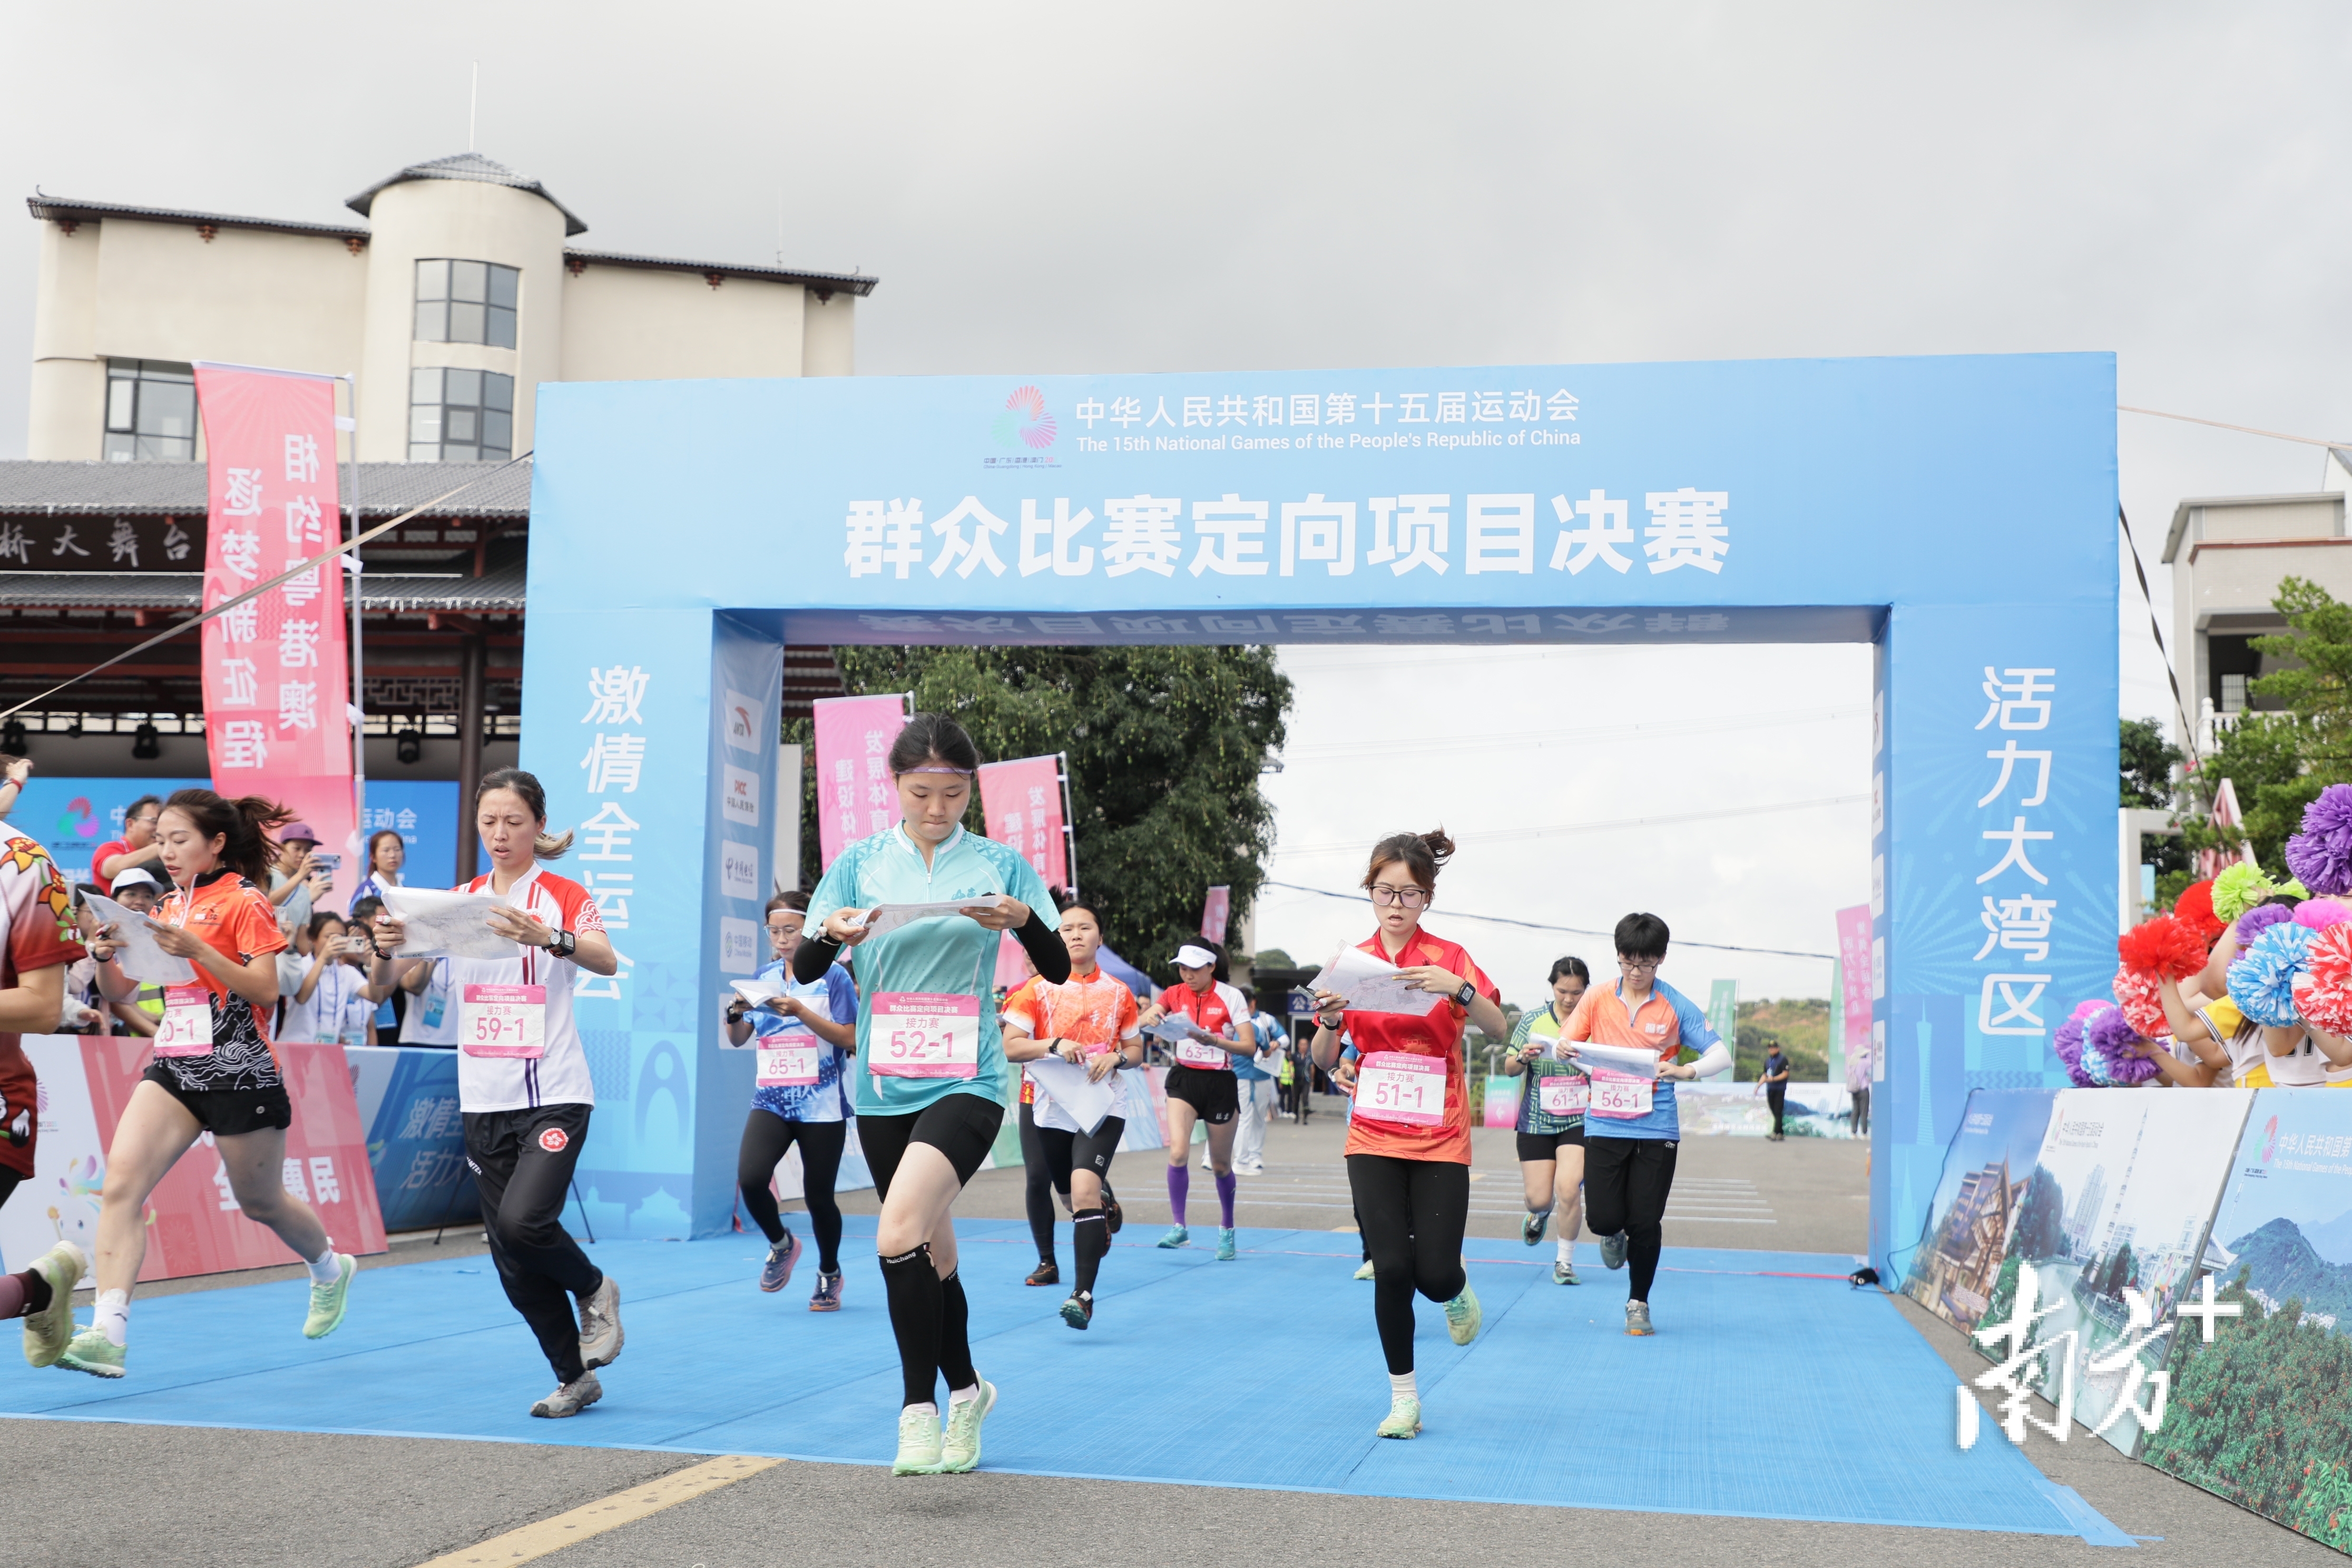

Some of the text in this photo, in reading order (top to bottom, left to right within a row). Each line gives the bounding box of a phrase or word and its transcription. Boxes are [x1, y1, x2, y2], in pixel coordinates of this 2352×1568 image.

[1076, 388, 1580, 429] 中华人民共和国第十五届运动会
[1076, 429, 1580, 452] The 15th National Games of the People's Republic of China
[842, 486, 1730, 580] 群众比赛定向项目决赛
[573, 665, 650, 1001] 激情全运会
[1973, 666, 2057, 1036] 活力大湾区
[487, 1005, 512, 1015] 接力赛
[889, 1005, 959, 1014] 群众比赛定向项目决赛
[476, 1017, 524, 1041] 59-1
[905, 1017, 939, 1028] 接力赛
[889, 1030, 954, 1058] 52-1
[1185, 1045, 1215, 1060] 63-1
[769, 1057, 806, 1075] 65-1
[1375, 1061, 1430, 1072] 群众比赛定向项目决赛
[1387, 1072, 1415, 1083] 接力赛
[1375, 1082, 1423, 1109] 51-1
[1552, 1092, 1580, 1106] 61-1
[1601, 1091, 1639, 1109] 56-1
[886, 1251, 916, 1264] Huichang
